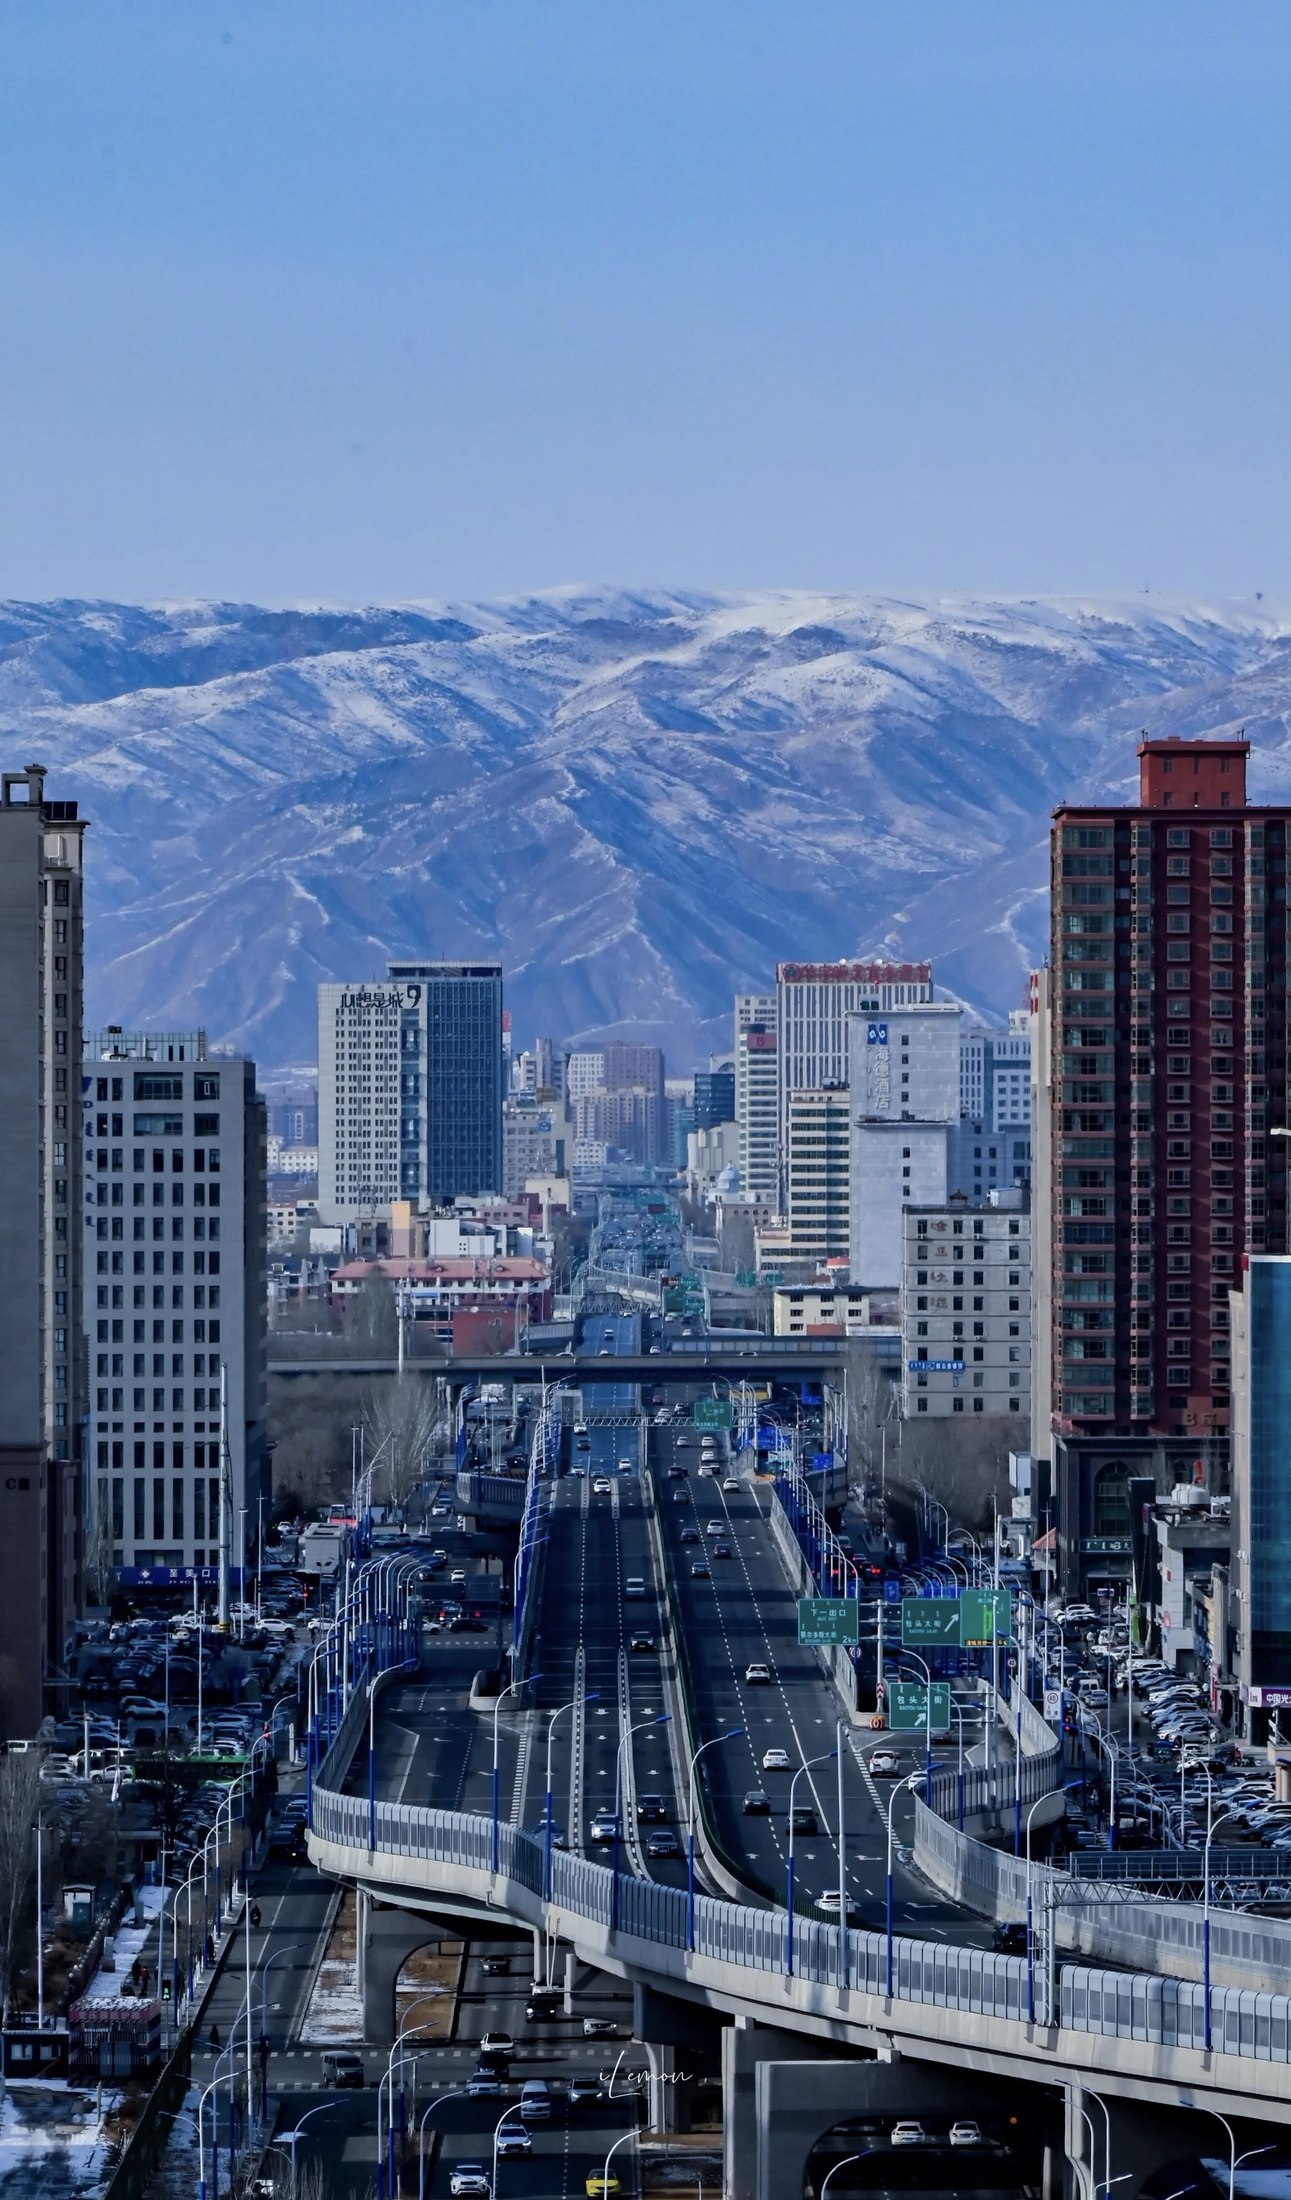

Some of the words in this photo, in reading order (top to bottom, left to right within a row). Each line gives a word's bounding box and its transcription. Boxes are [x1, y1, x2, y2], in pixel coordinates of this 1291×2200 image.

[169, 1568, 221, 1578] 至美口
[810, 1608, 846, 1617] 下一出口
[905, 1619, 941, 1628] 包头大街
[897, 1695, 942, 1705] 包头大街
[1266, 1693, 1291, 1704] 中国光
